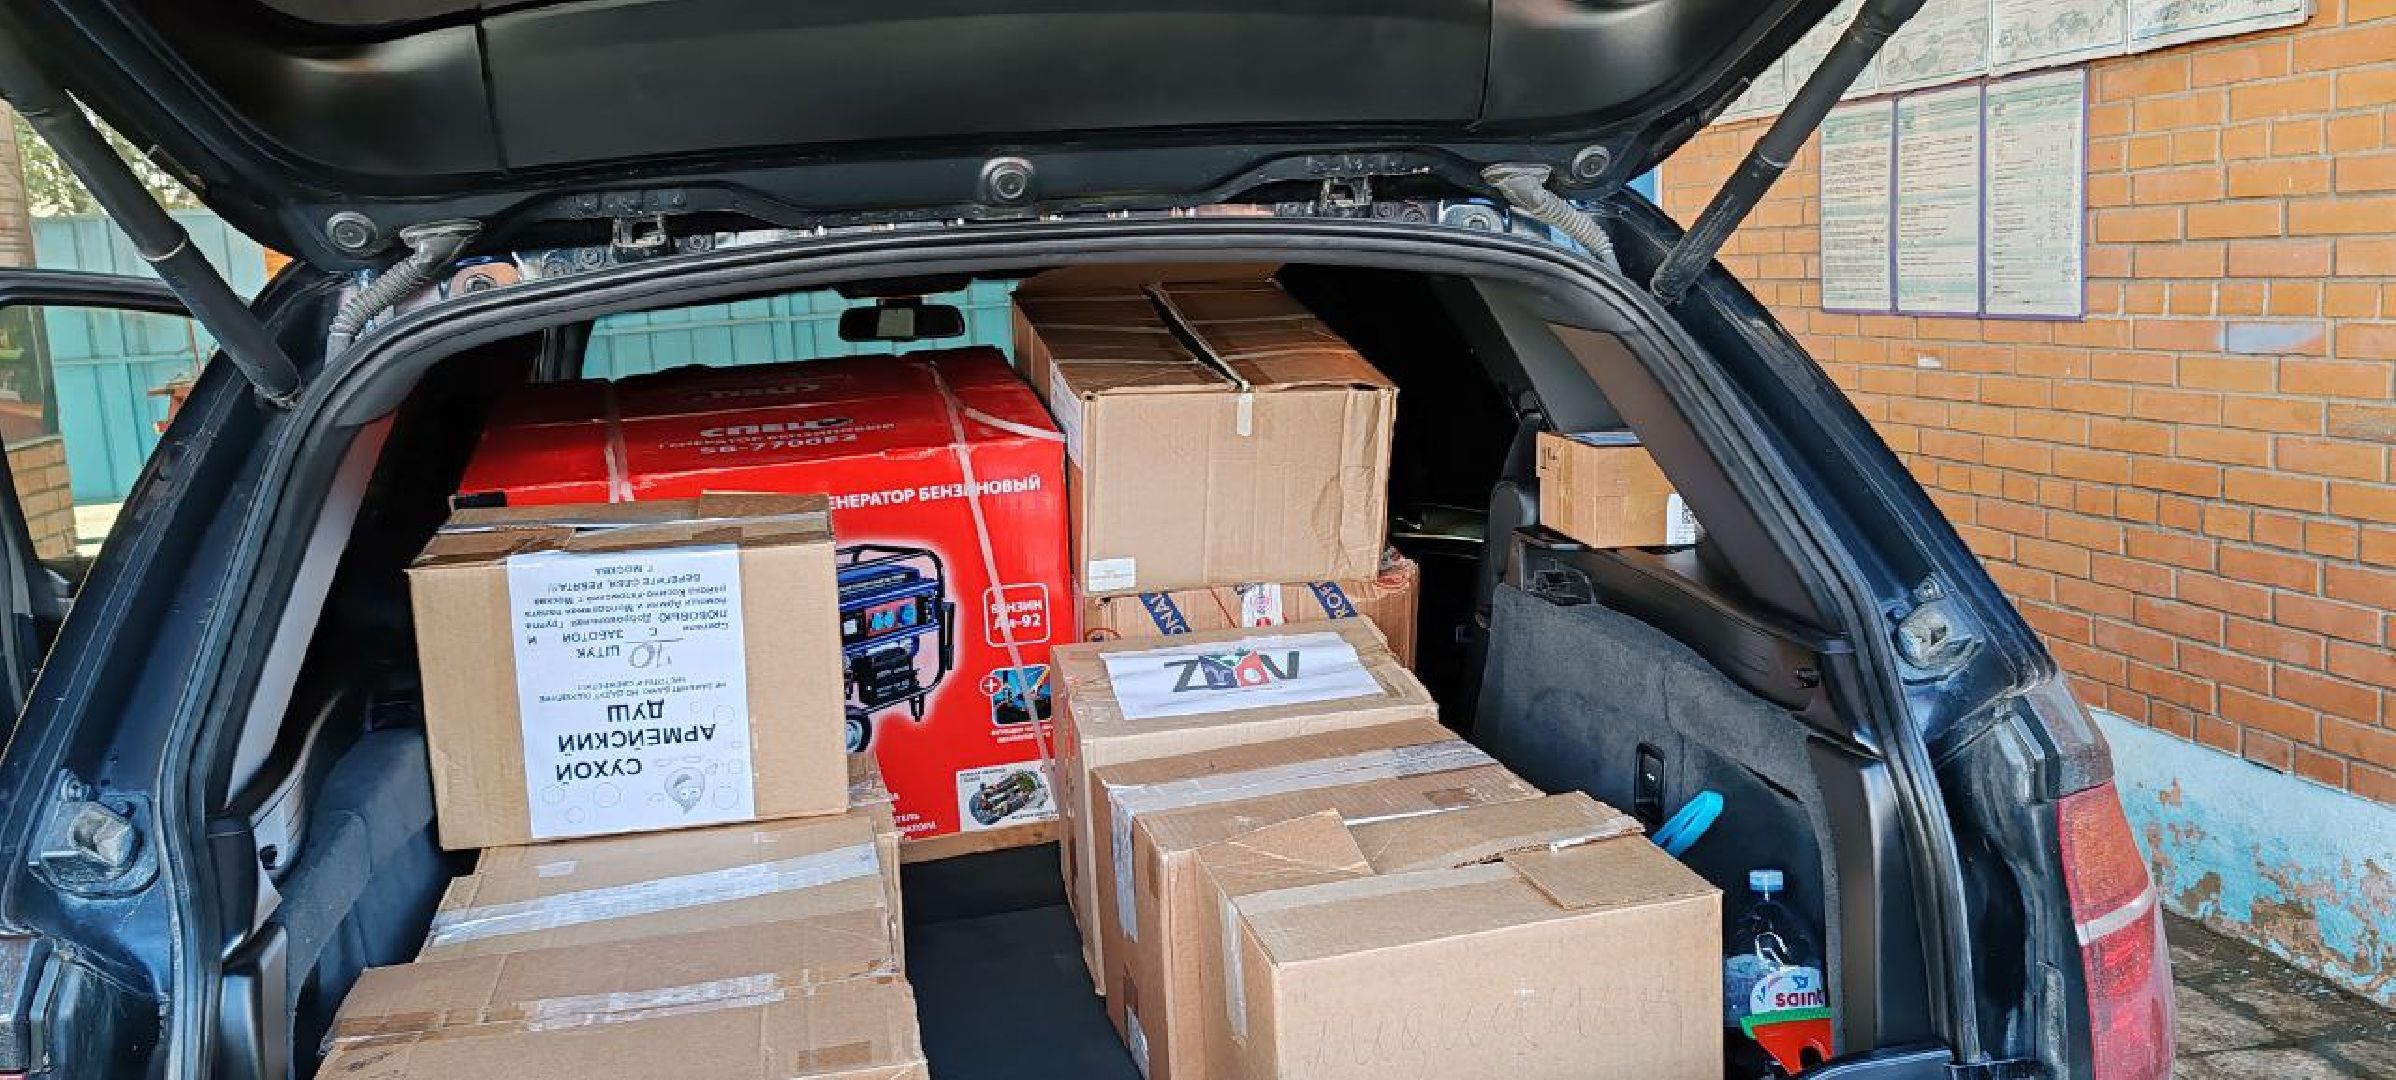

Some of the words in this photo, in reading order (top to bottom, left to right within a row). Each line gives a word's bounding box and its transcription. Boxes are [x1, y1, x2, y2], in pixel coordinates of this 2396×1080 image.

[828, 488, 915, 510] ЕНЕРАТОР
[643, 574, 701, 586] БЕРЕГИТЕ
[992, 599, 1043, 614] БНЗИН
[658, 609, 728, 624] ЛЮБОВЬЮ
[562, 628, 624, 643] ЗАБОТОЙ
[649, 627, 658, 636] С
[577, 645, 620, 658] ШТУК
[607, 699, 665, 723] ДУШ
[558, 724, 717, 755] АРМЕЙСКИЙ
[556, 758, 643, 785] СУХОЙ
[1775, 987, 1823, 1008] saint
